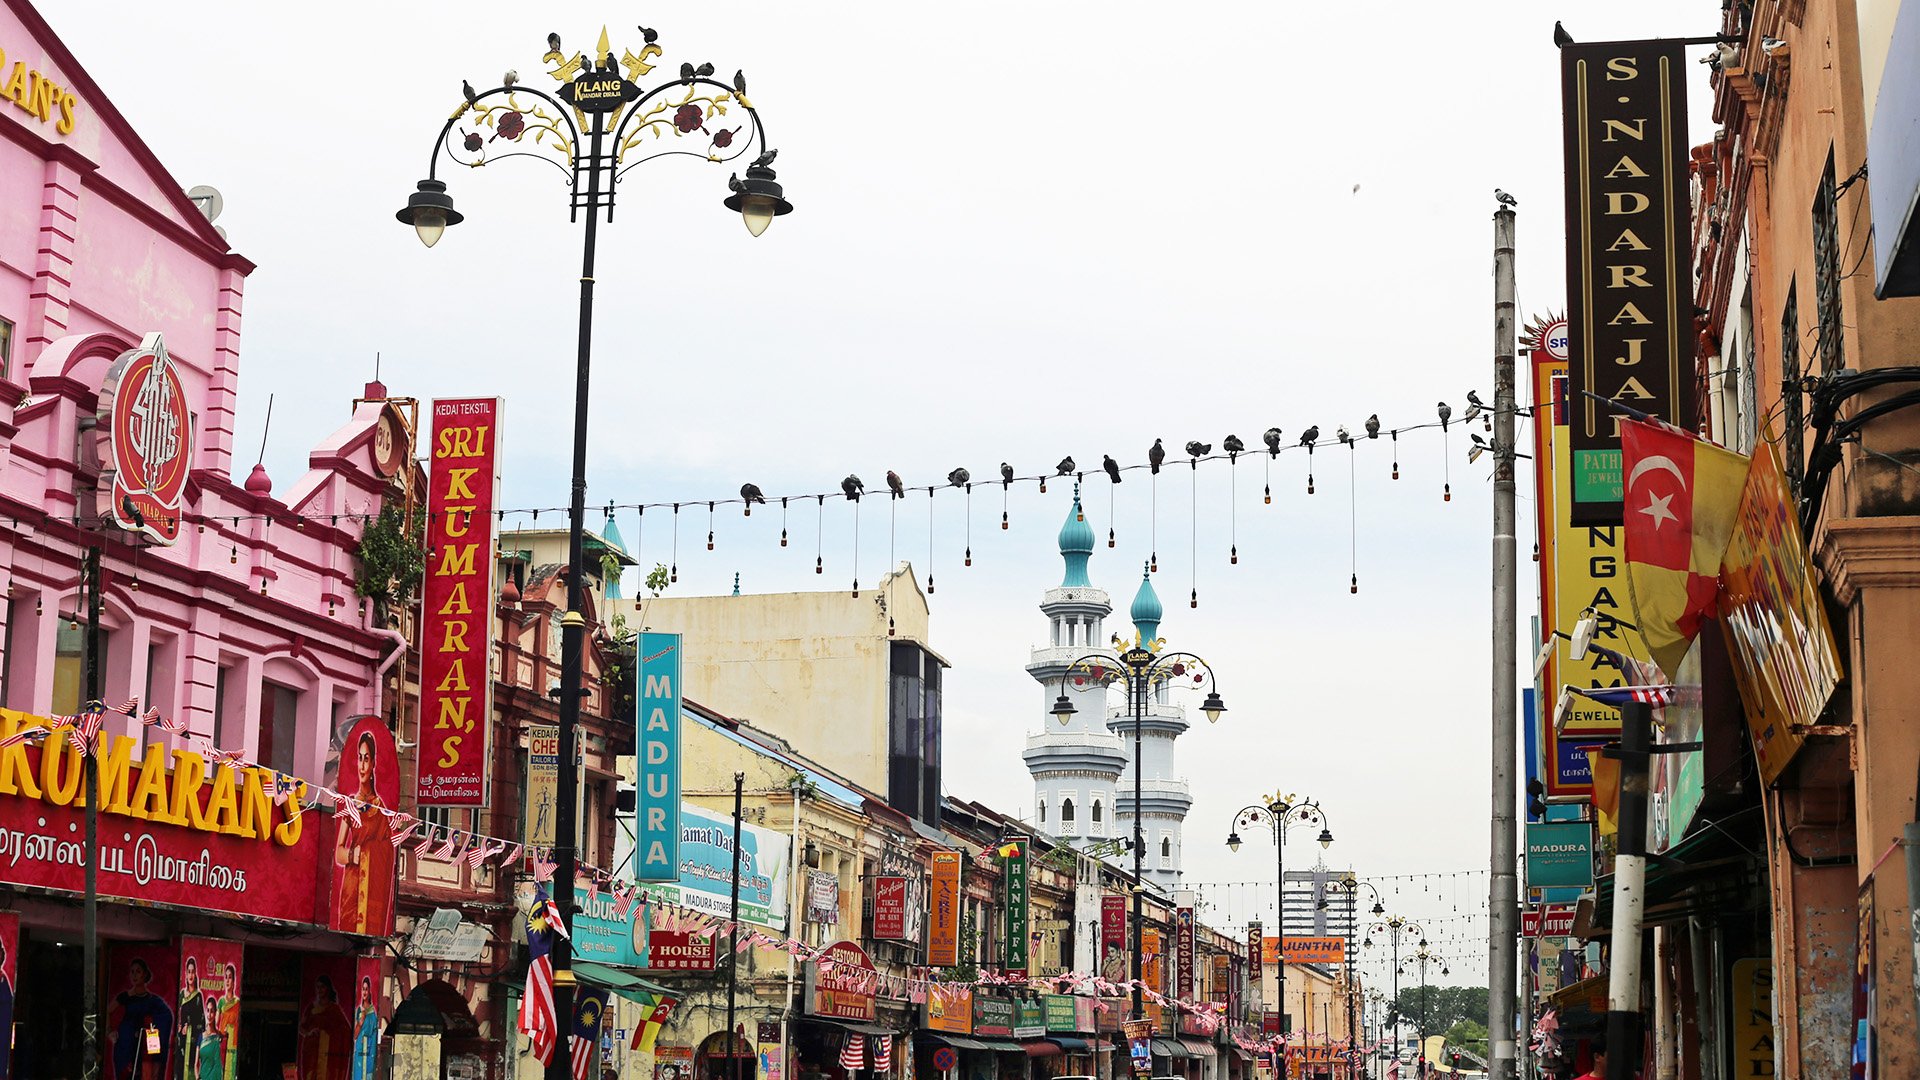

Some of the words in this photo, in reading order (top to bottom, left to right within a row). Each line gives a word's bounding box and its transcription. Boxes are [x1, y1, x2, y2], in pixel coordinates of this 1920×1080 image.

[575, 81, 621, 101] KLANG
[436, 404, 458, 415] KEDAI
[461, 402, 490, 414] TEKSTIL
[436, 426, 488, 459] SRI
[1567, 711, 1622, 721] JEWELL
[532, 729, 551, 739] KEDAI
[532, 756, 552, 764] TAILOR
[644, 675, 672, 865] MADURA
[715, 828, 751, 871] Datng
[1530, 844, 1587, 852] MADURA
[685, 893, 713, 909] MADURA
[713, 900, 732, 913] STORES
[1011, 864, 1021, 963] HANIFFA
[660, 946, 711, 956] HOUSE
[832, 948, 862, 966] RESTORAN
[1249, 930, 1261, 979] Salem
[1042, 967, 1065, 975] VASU
